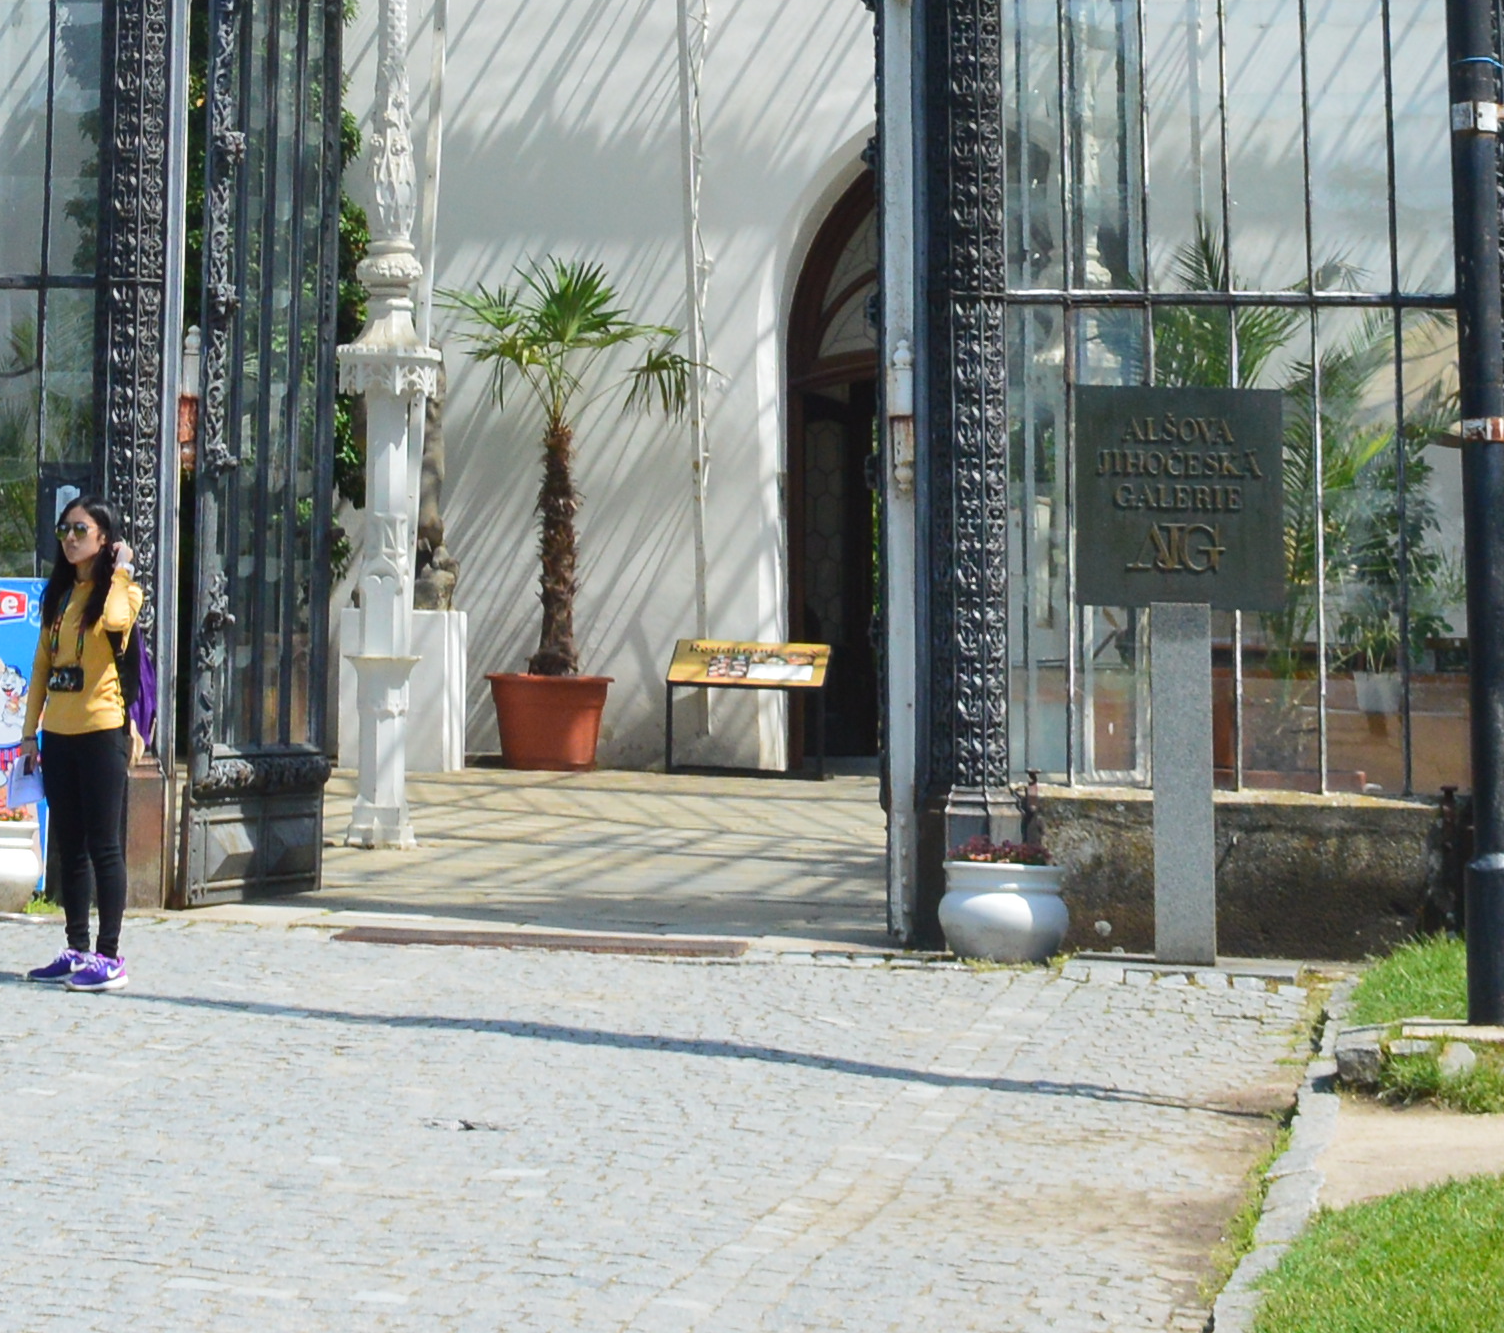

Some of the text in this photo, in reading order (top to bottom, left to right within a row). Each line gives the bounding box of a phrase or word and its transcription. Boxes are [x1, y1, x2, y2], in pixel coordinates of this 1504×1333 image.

[1121, 412, 1234, 444] ALŠOVA
[1095, 447, 1263, 479] JIHOČESKÁ
[1113, 484, 1243, 512] GALERIE
